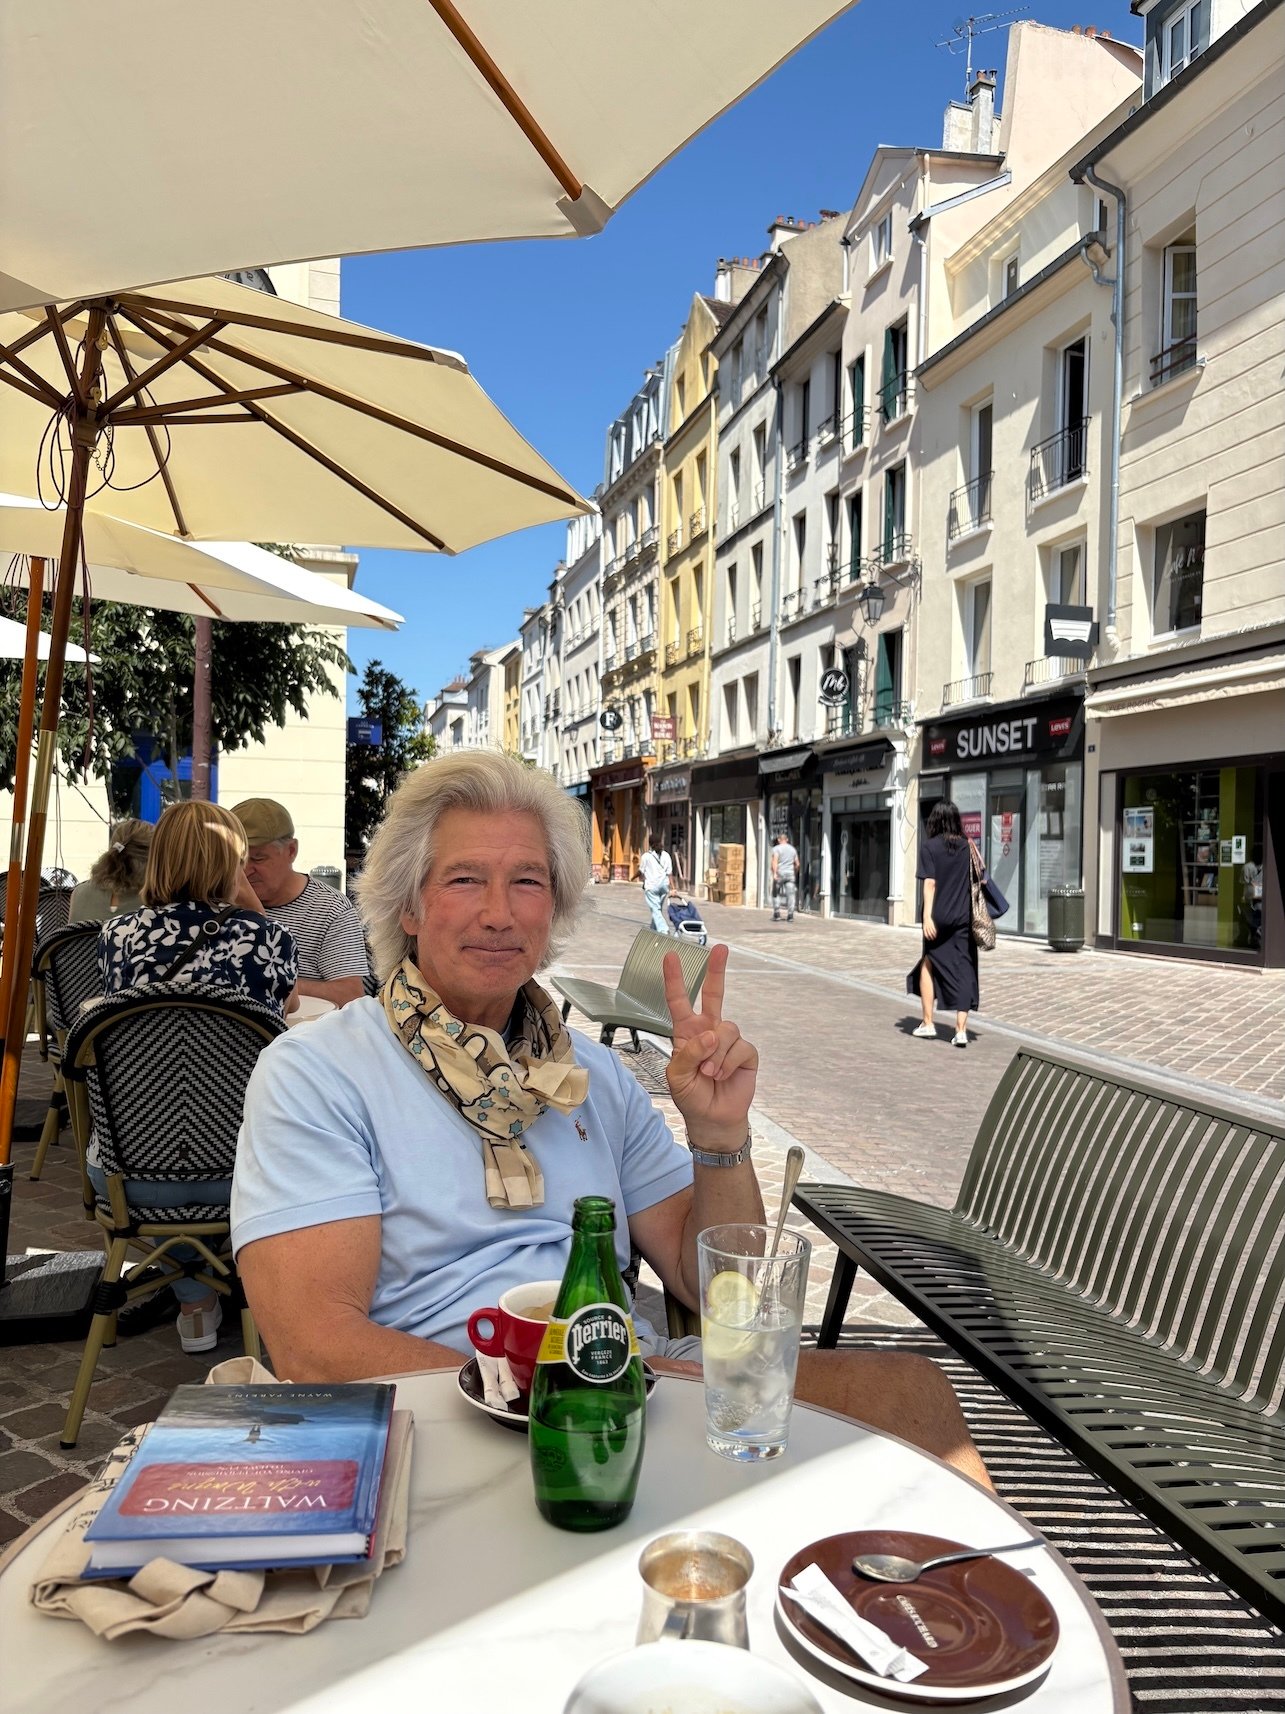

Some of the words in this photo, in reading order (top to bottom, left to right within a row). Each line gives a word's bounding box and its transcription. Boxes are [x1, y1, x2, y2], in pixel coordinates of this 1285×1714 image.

[956, 717, 1038, 759] SUNSET
[962, 823, 981, 833] OUER
[583, 1315, 605, 1324] SOURCE
[144, 1496, 327, 1511] WALTZING
